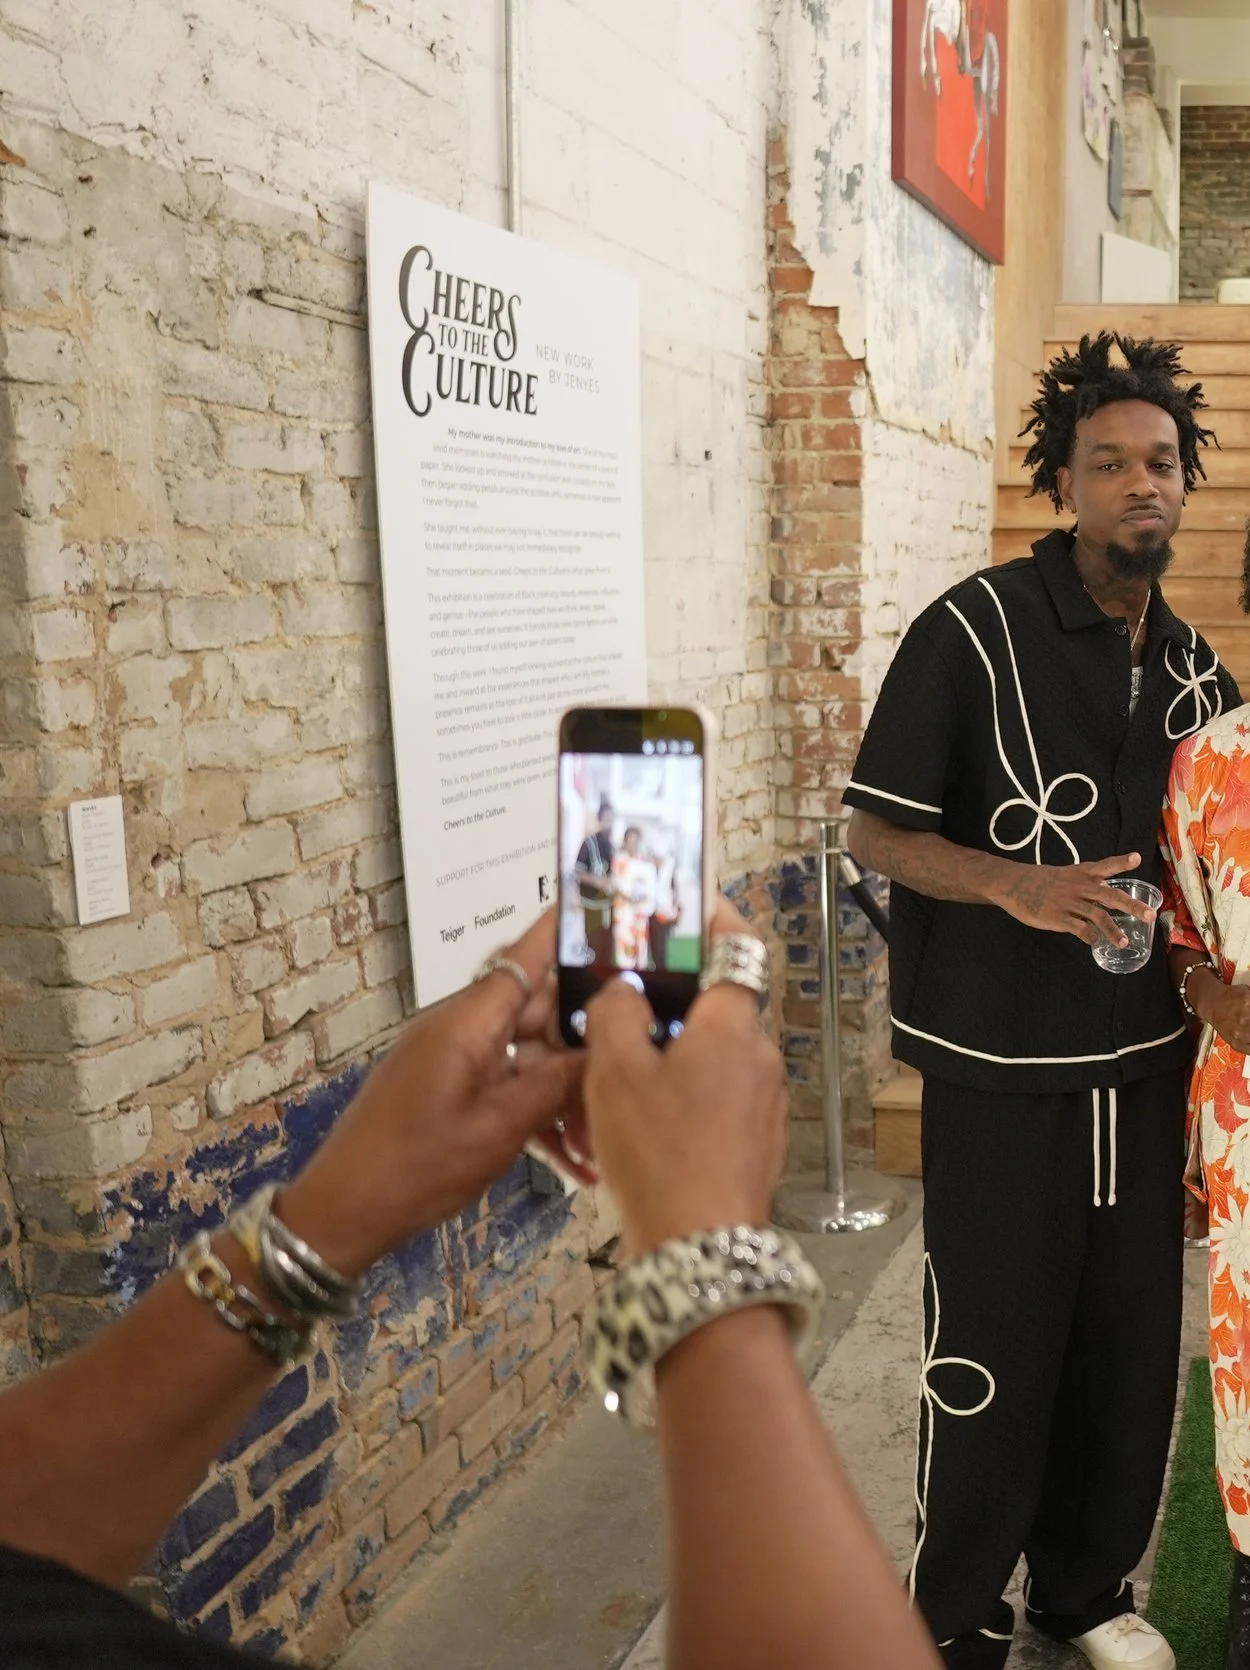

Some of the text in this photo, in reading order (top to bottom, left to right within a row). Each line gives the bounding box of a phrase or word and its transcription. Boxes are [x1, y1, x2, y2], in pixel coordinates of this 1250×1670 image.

[399, 245, 521, 362] CHEERS
[438, 323, 489, 358] TO THE
[401, 328, 539, 418] CULTURE
[536, 344, 594, 372] NEW WORK
[549, 370, 600, 394] BY JENYES
[459, 430, 481, 441] mother
[483, 434, 495, 442] was
[436, 868, 468, 888] SUPPORT
[471, 862, 485, 875] FOR
[486, 856, 500, 868] THIS
[440, 903, 516, 944] Teiger Foundation
